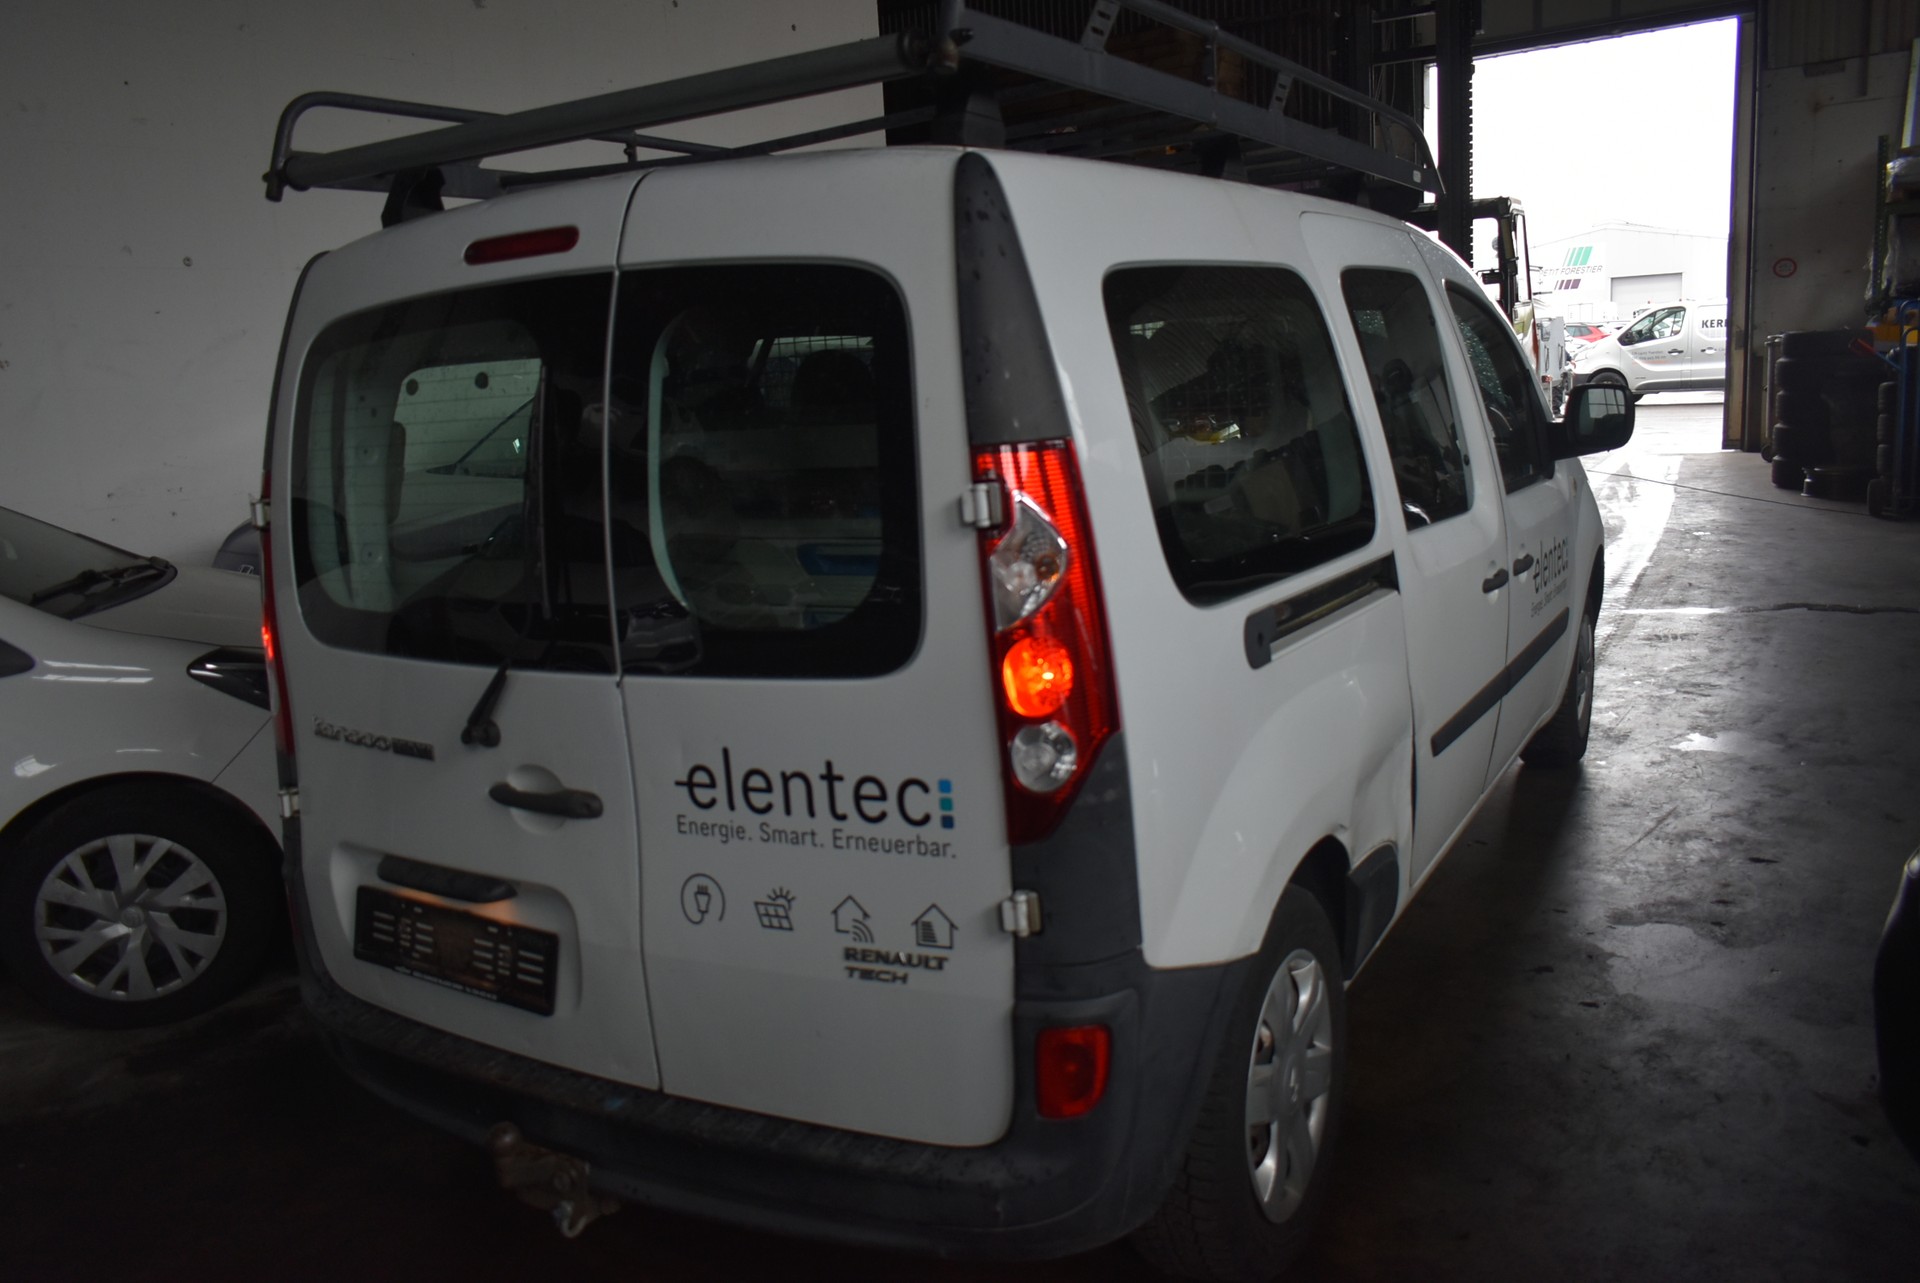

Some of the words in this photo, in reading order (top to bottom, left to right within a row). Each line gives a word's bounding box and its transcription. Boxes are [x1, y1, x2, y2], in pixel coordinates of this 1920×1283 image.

[1560, 265, 1603, 275] FORESTIER
[1701, 318, 1727, 329] KER
[1533, 536, 1566, 595] elentec
[674, 746, 932, 827] elentec
[676, 814, 753, 844] Energie.
[759, 822, 825, 849] Smart.
[832, 828, 957, 859] Erneuerbar.
[843, 947, 949, 971] RENAULT
[844, 966, 910, 985] TECH
